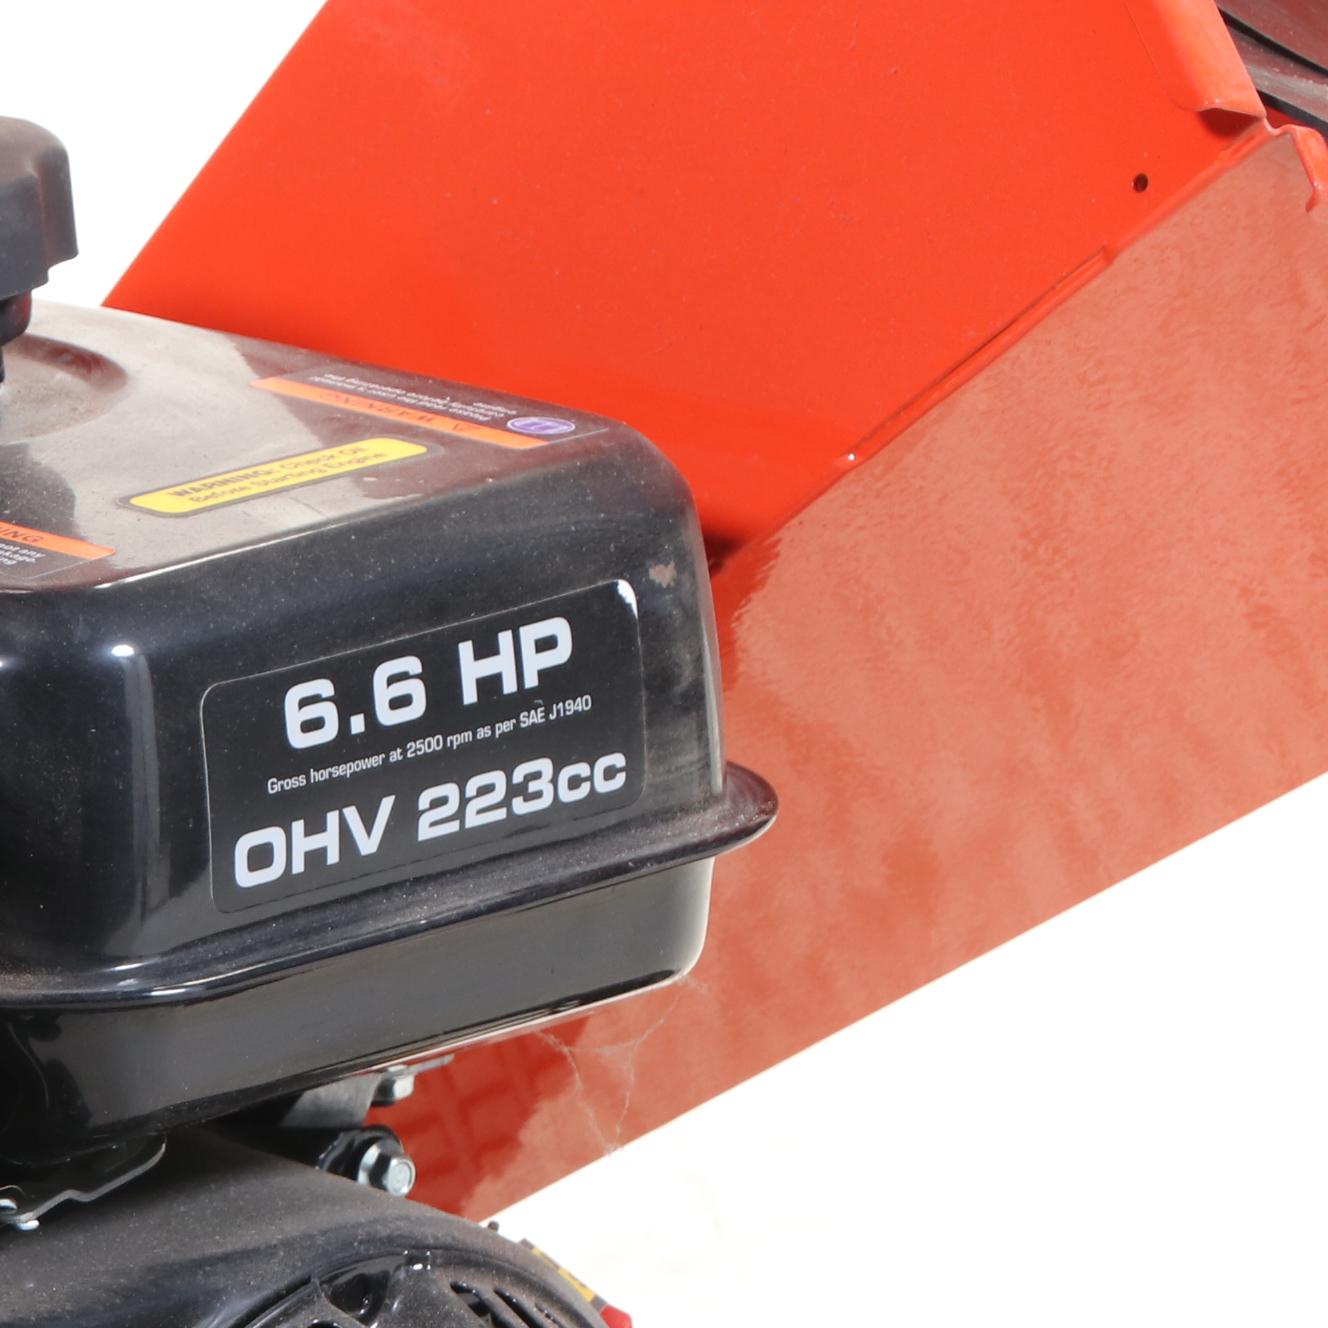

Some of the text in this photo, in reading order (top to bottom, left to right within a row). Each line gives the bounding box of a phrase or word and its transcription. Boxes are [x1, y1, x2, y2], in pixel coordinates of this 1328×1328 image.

[267, 694, 592, 794] Gross horsepower at 2500 rpm as per SAE J1940
[284, 616, 573, 750] 6.6 HP
[234, 752, 627, 889] OHV 223cc
